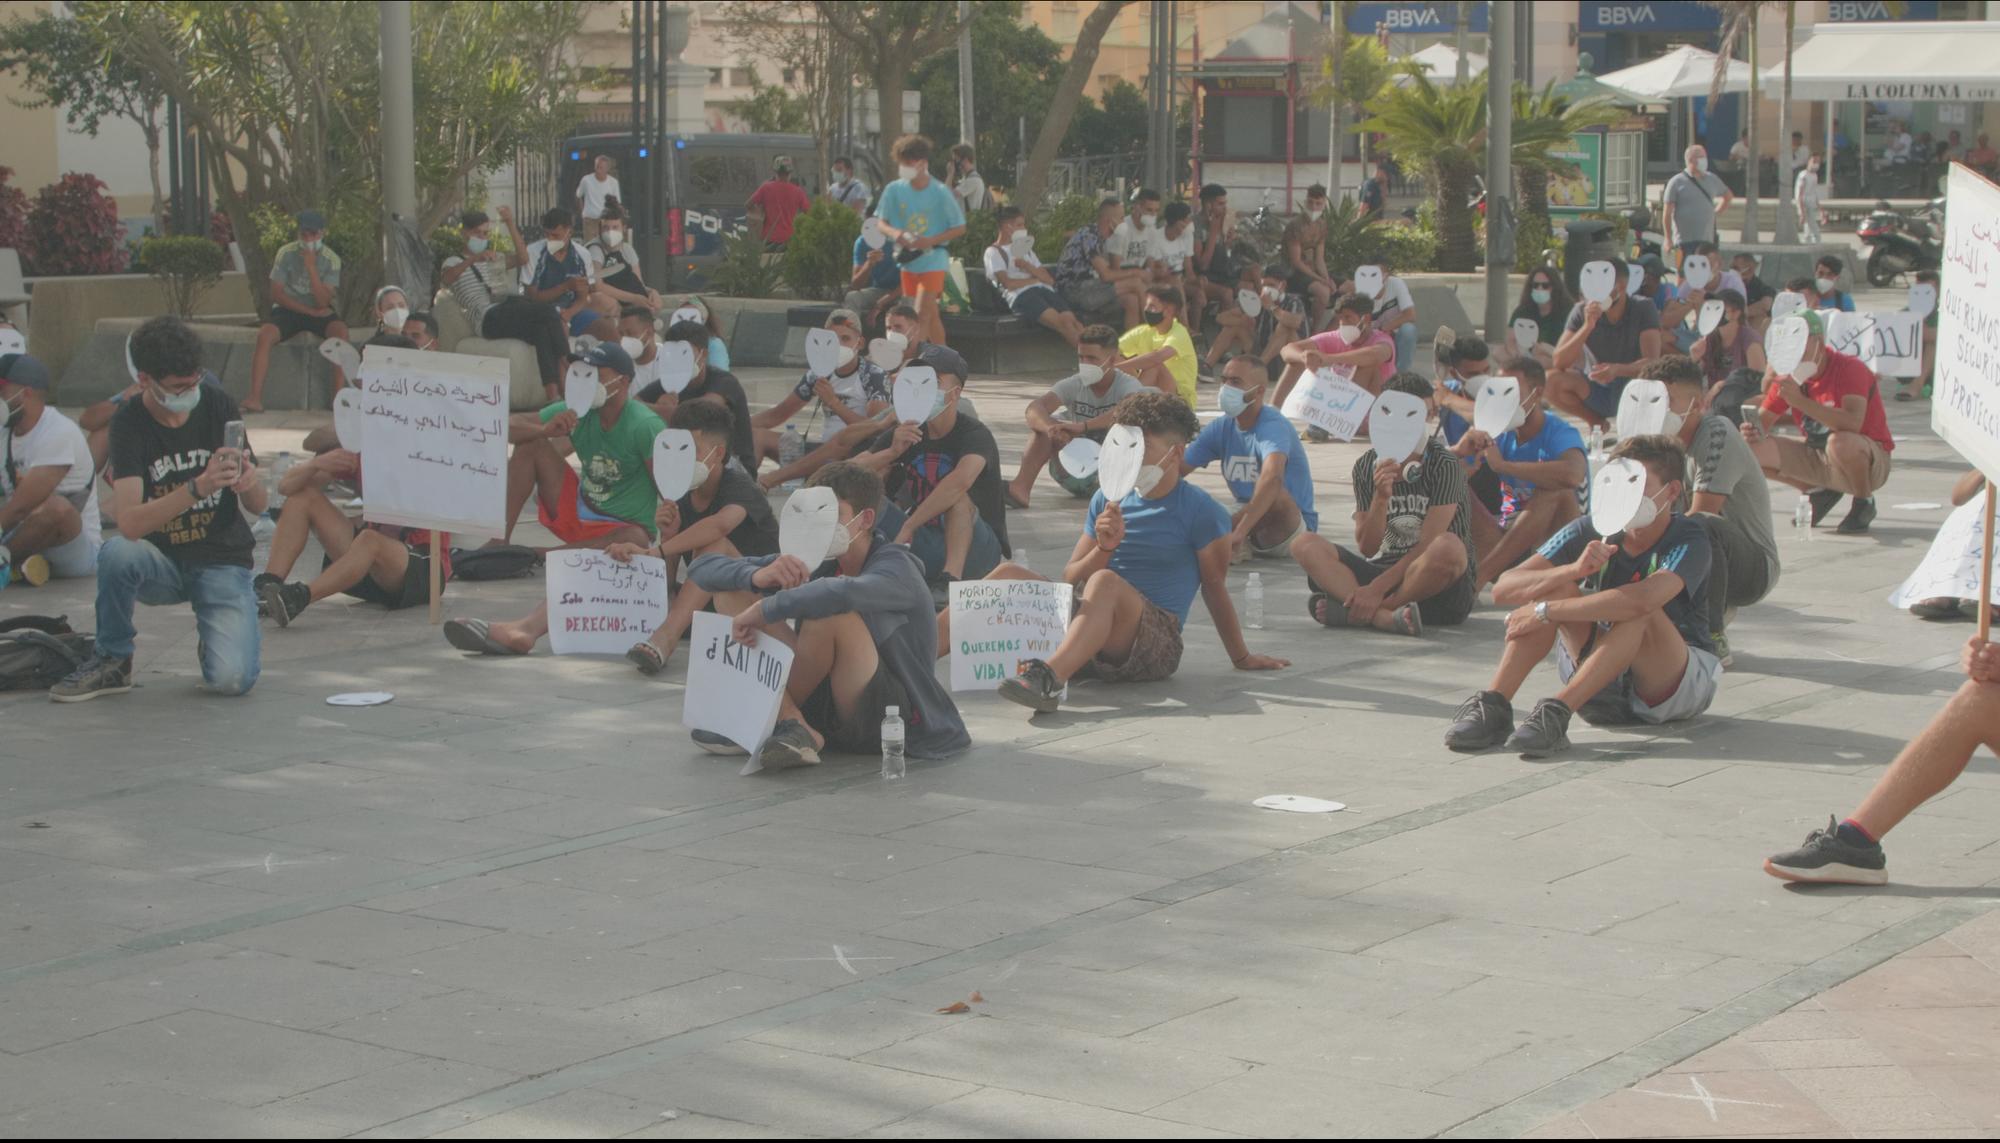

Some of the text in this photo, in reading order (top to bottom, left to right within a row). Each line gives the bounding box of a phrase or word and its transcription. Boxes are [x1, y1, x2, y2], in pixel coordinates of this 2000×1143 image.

[1385, 8, 1440, 28] BBVA
[1597, 6, 1656, 25] BBVA
[1829, 3, 1888, 21] BBVA
[1847, 84, 1868, 98] LA
[1875, 84, 1960, 98] COLUMNA
[560, 592, 584, 605] Solo
[565, 616, 627, 632] DERECHOS
[960, 638, 1021, 655] QUEREMOS
[973, 663, 1006, 681] VIDA
